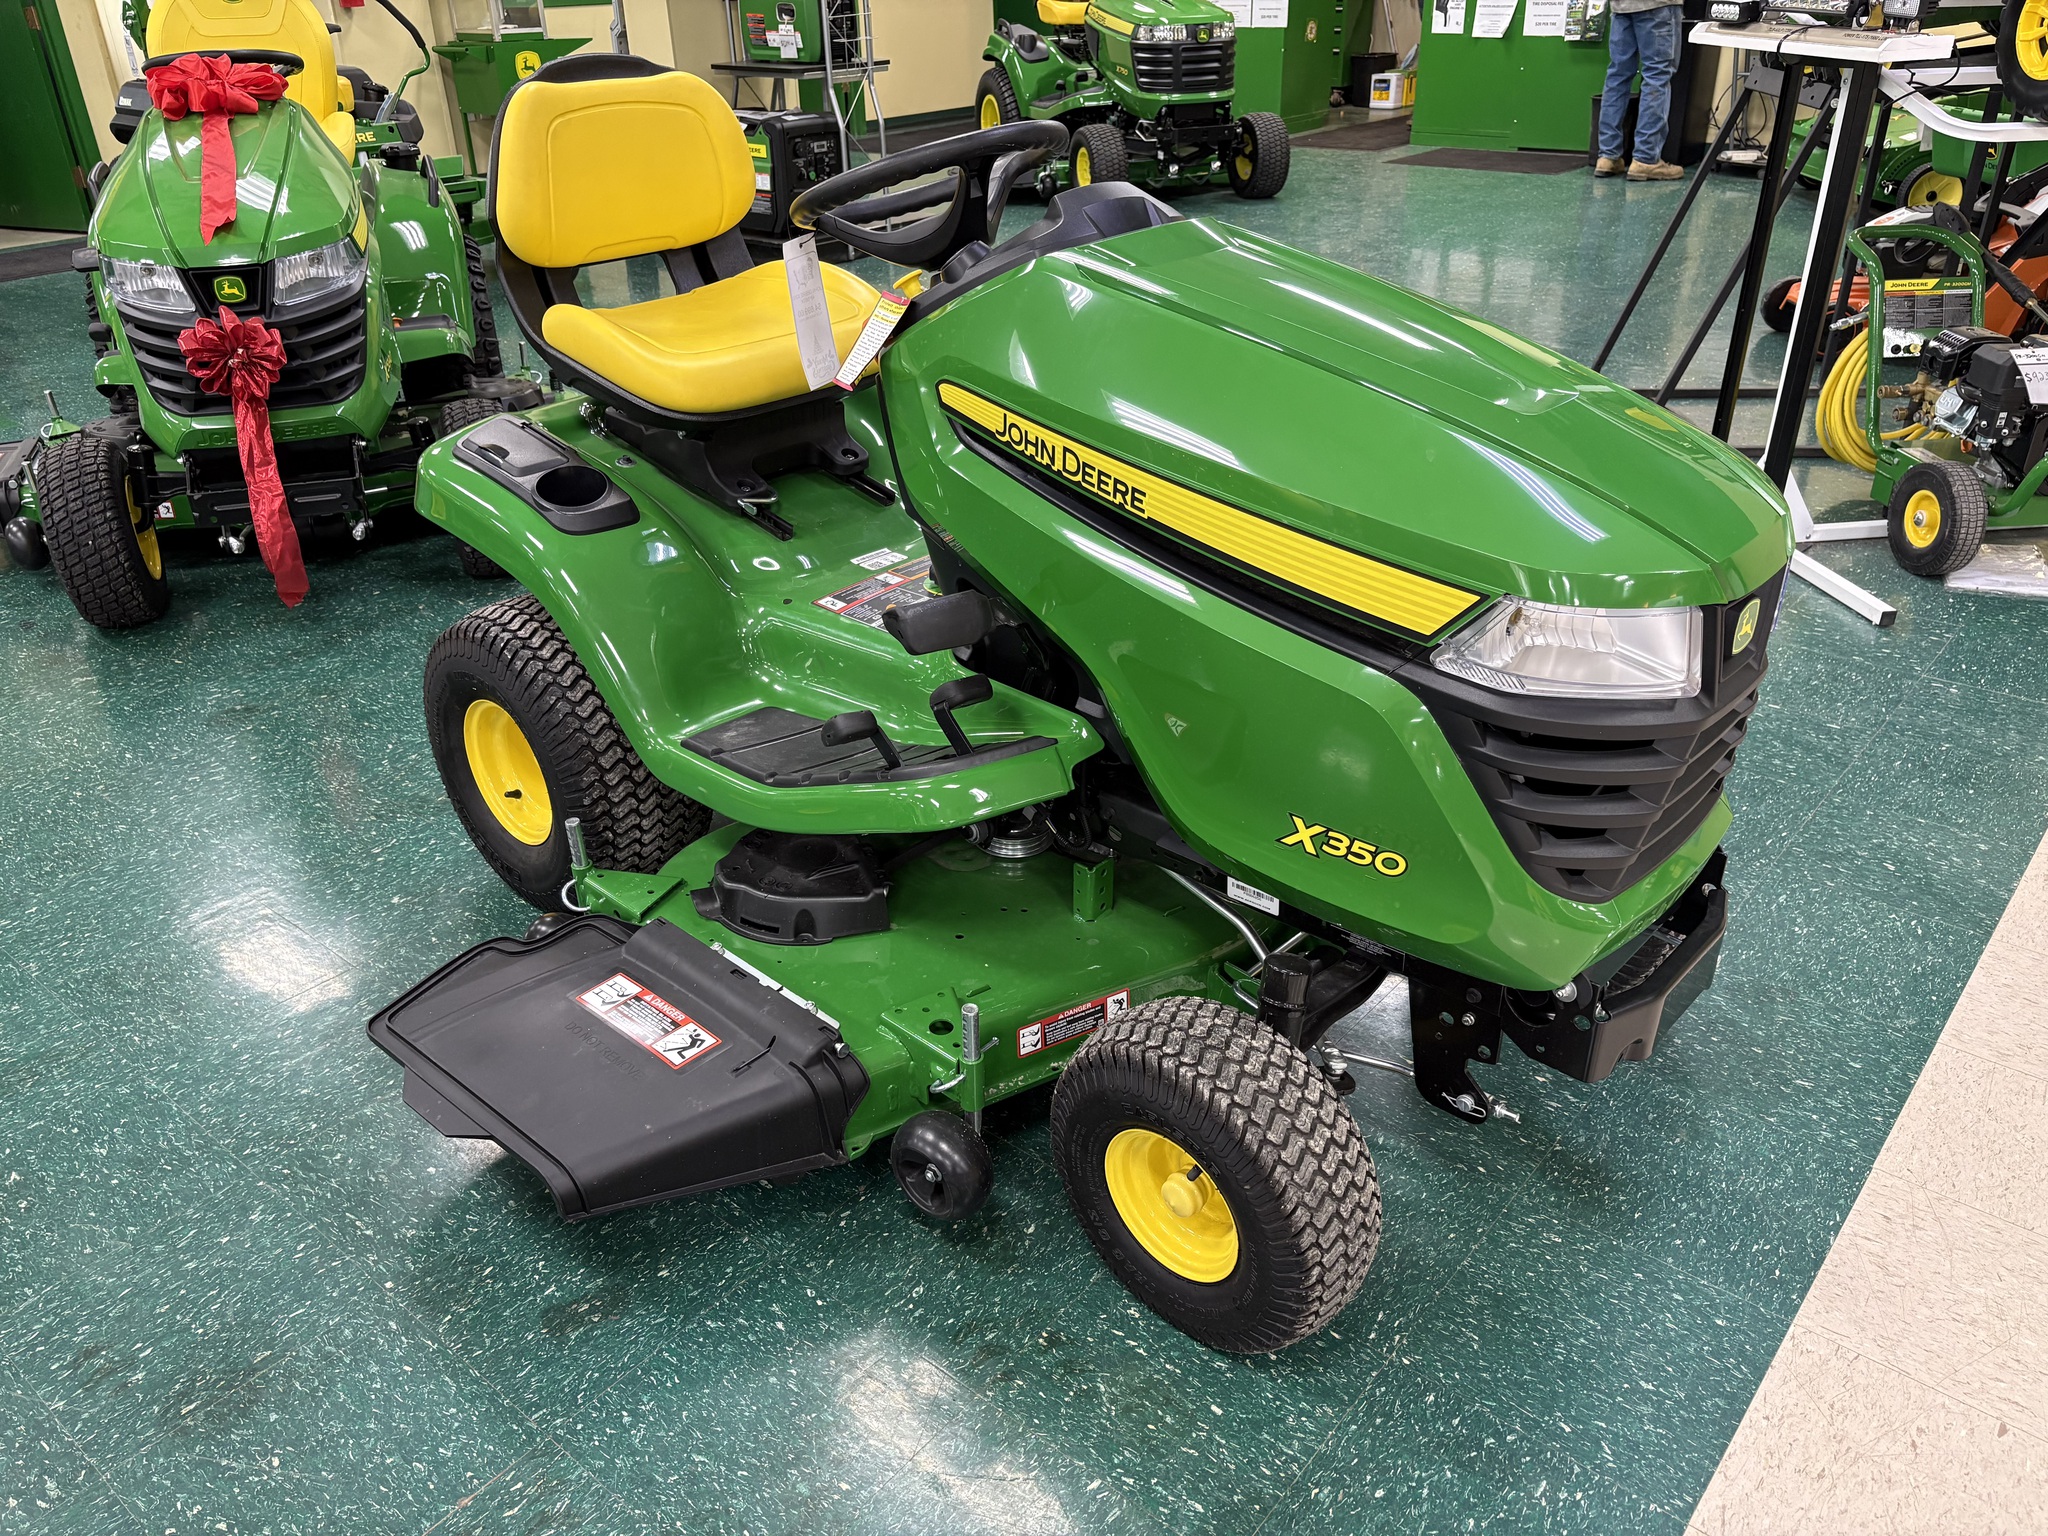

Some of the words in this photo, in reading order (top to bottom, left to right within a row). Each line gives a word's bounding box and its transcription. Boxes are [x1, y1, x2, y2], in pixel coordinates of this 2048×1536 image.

[995, 413, 1056, 467] JOHN
[1063, 445, 1147, 515] DEERE
[1275, 811, 1408, 878] X350
[651, 998, 686, 1021] DANGER
[1064, 1002, 1092, 1017] DANGER
[581, 1032, 606, 1051] NOT
